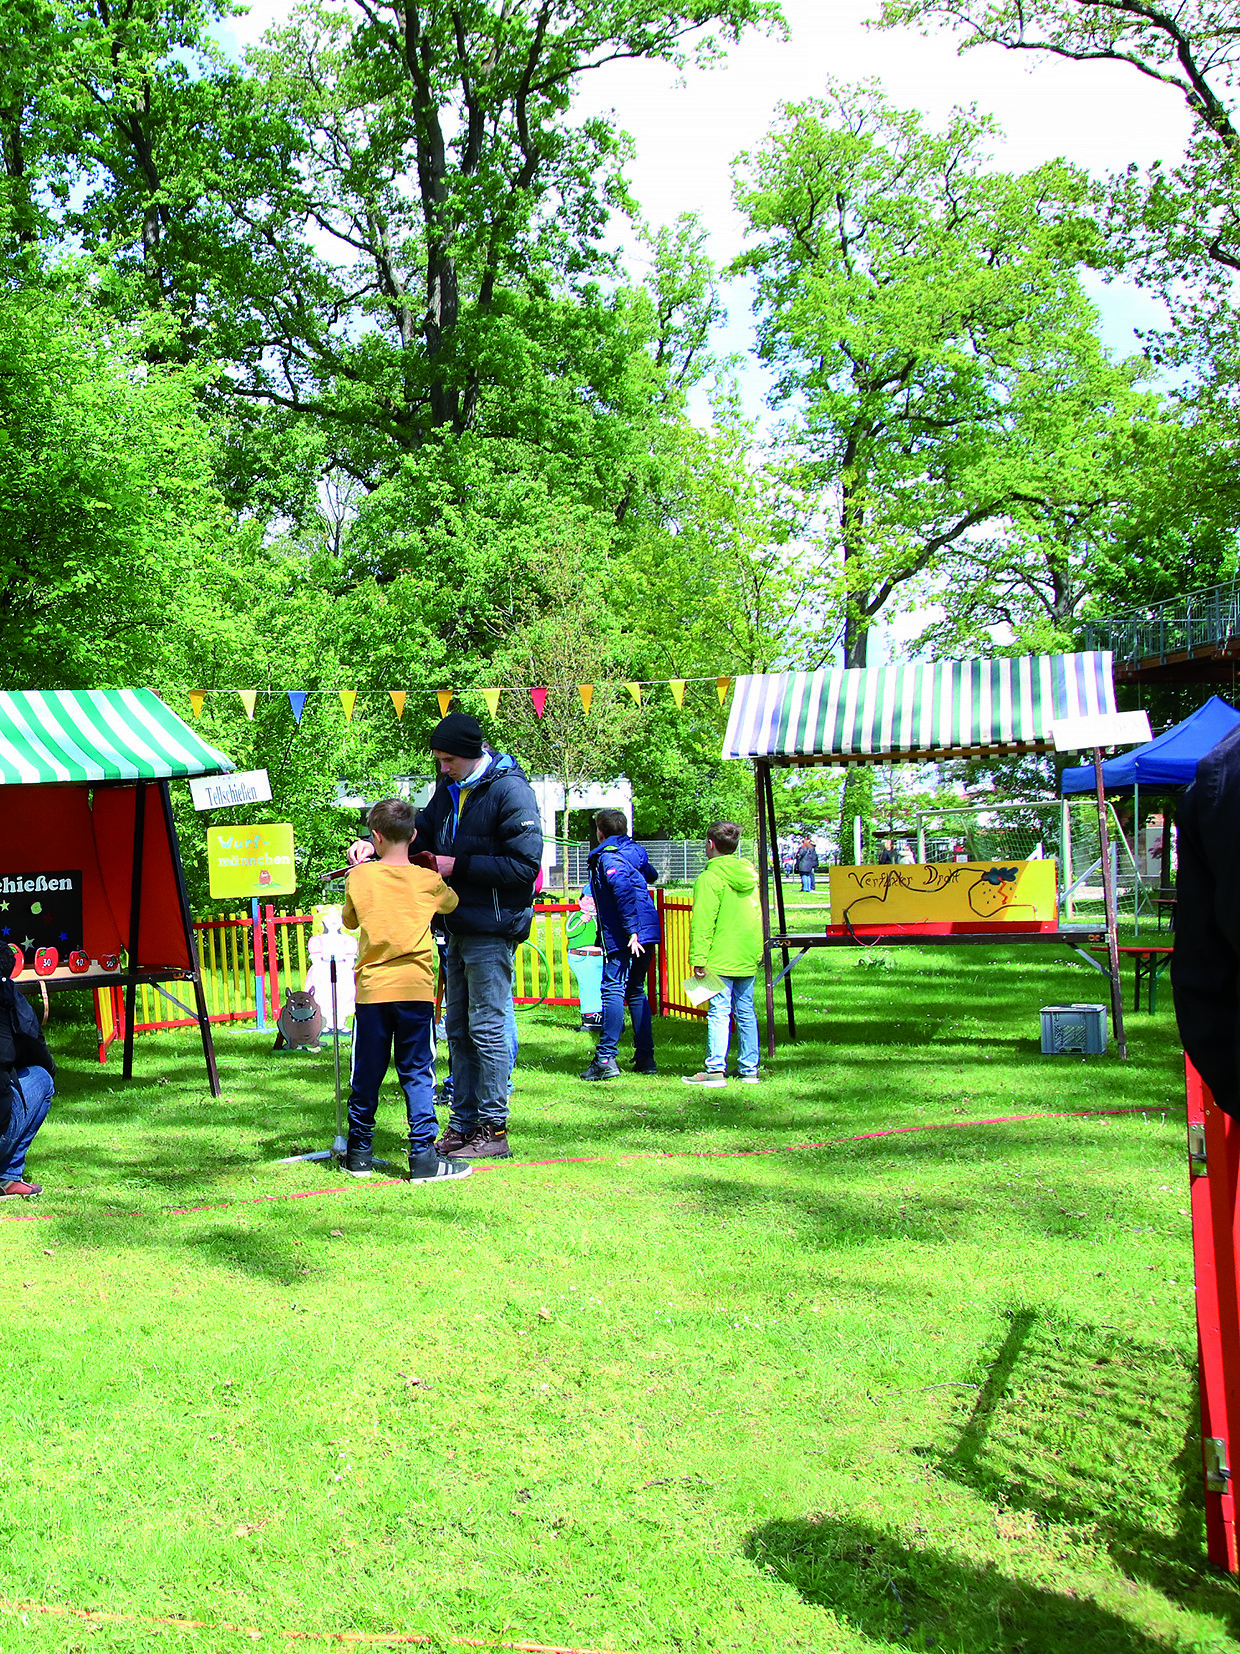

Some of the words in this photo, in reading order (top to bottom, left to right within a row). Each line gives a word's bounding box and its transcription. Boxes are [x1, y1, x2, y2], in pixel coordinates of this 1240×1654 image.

[205, 782, 258, 807] Tellschießen
[216, 834, 270, 849] Wurf-
[218, 852, 291, 867] männchen
